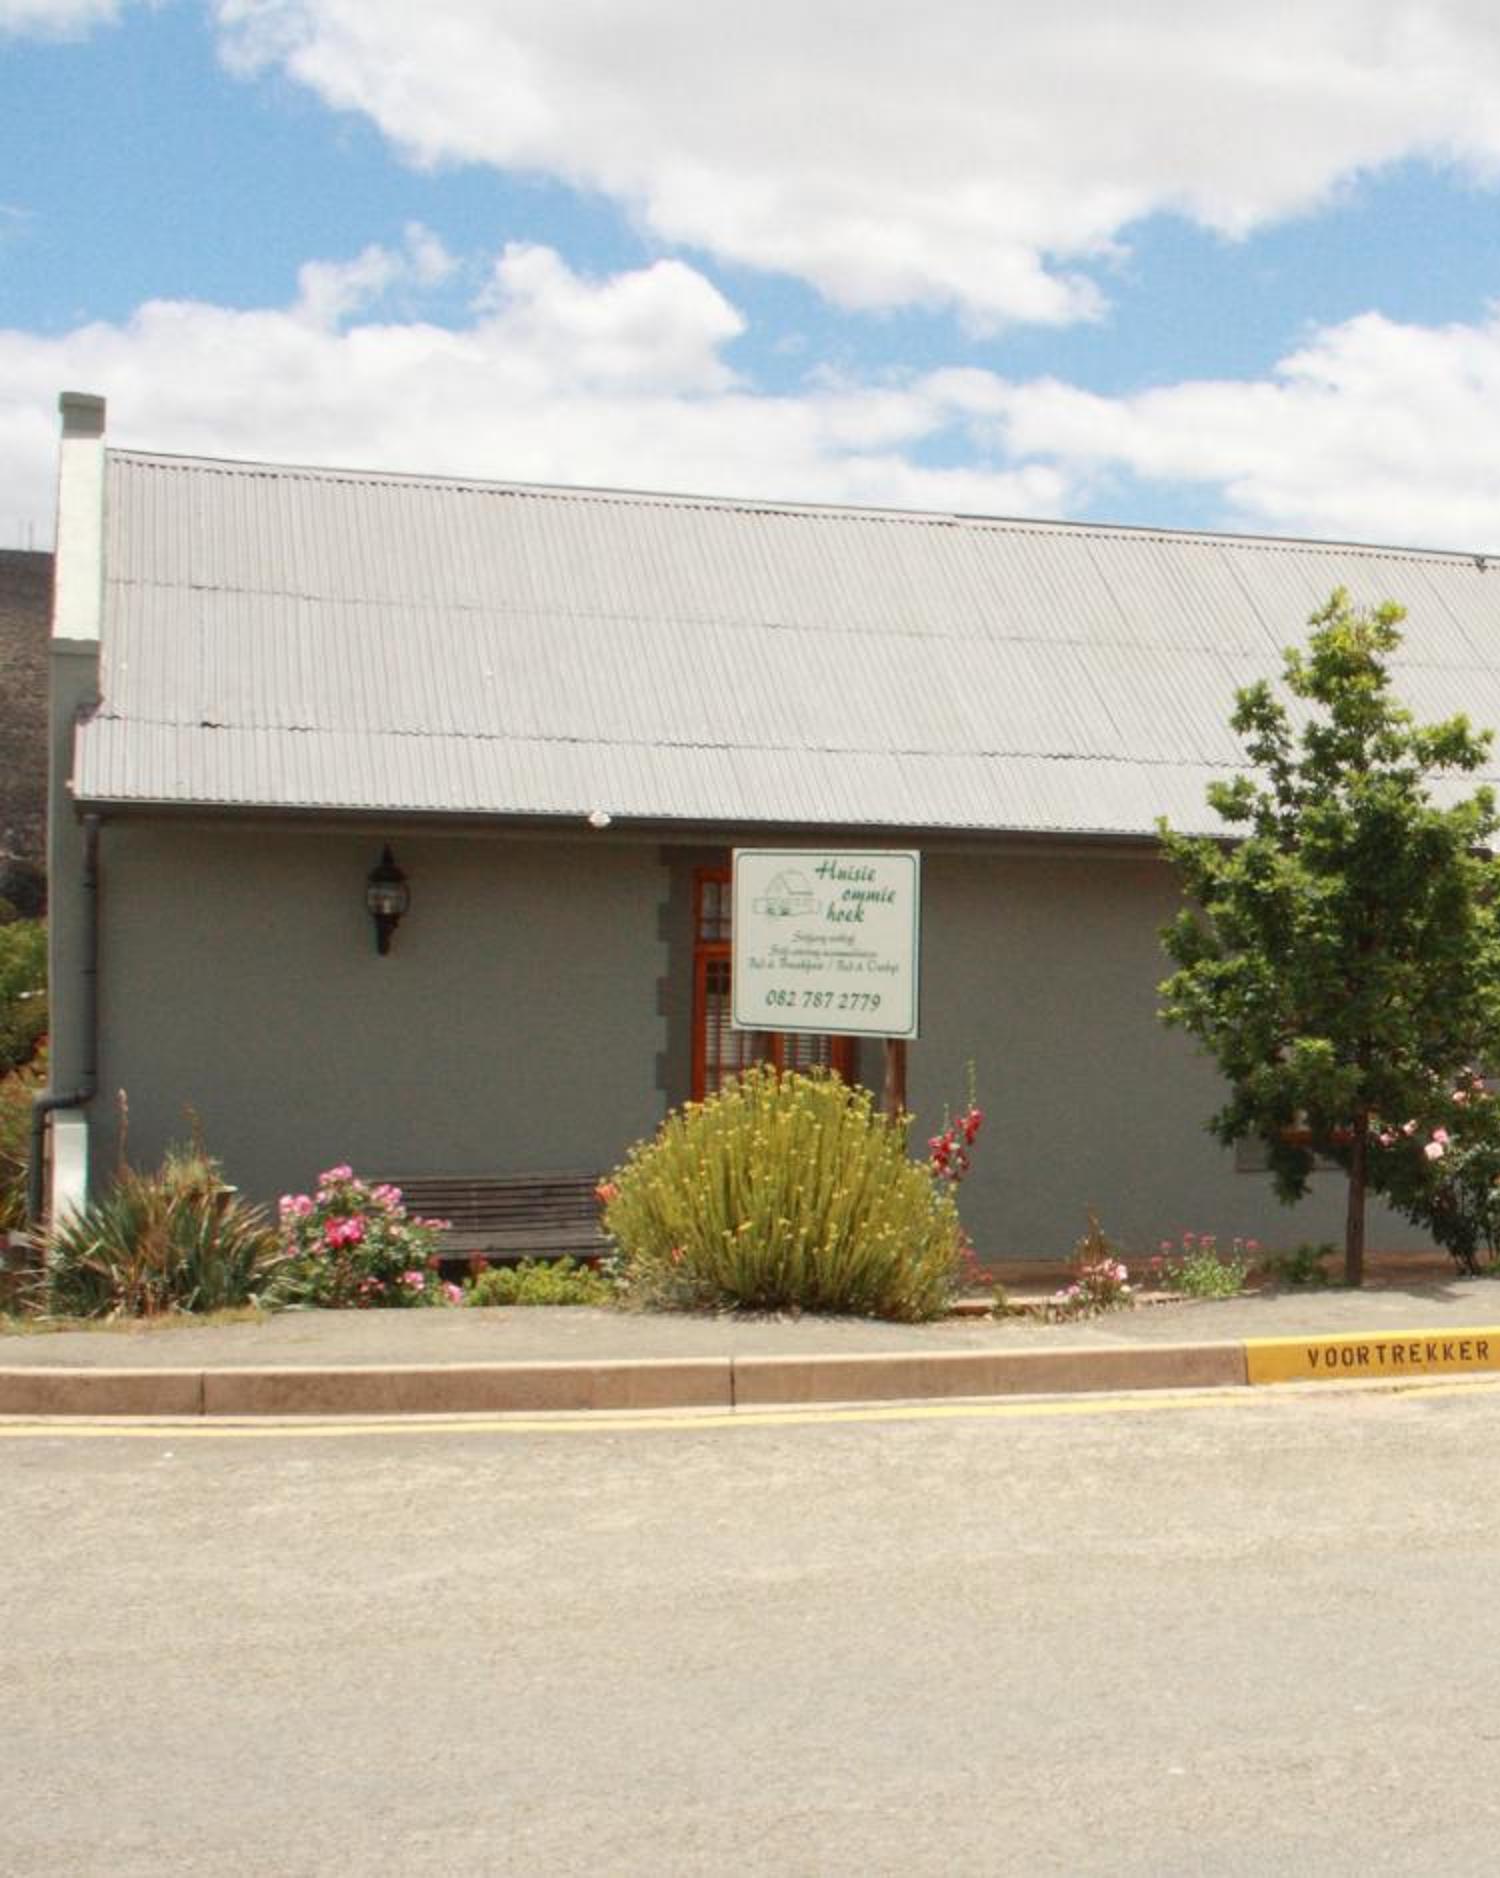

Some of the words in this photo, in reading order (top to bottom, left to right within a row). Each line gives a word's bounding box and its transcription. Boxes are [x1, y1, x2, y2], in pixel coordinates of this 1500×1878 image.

[815, 859, 876, 882] Huisie
[766, 989, 797, 1008] 082
[801, 990, 834, 1009] 787
[838, 992, 882, 1012] 2779
[1307, 1340, 1489, 1368] VOORTREKKER
